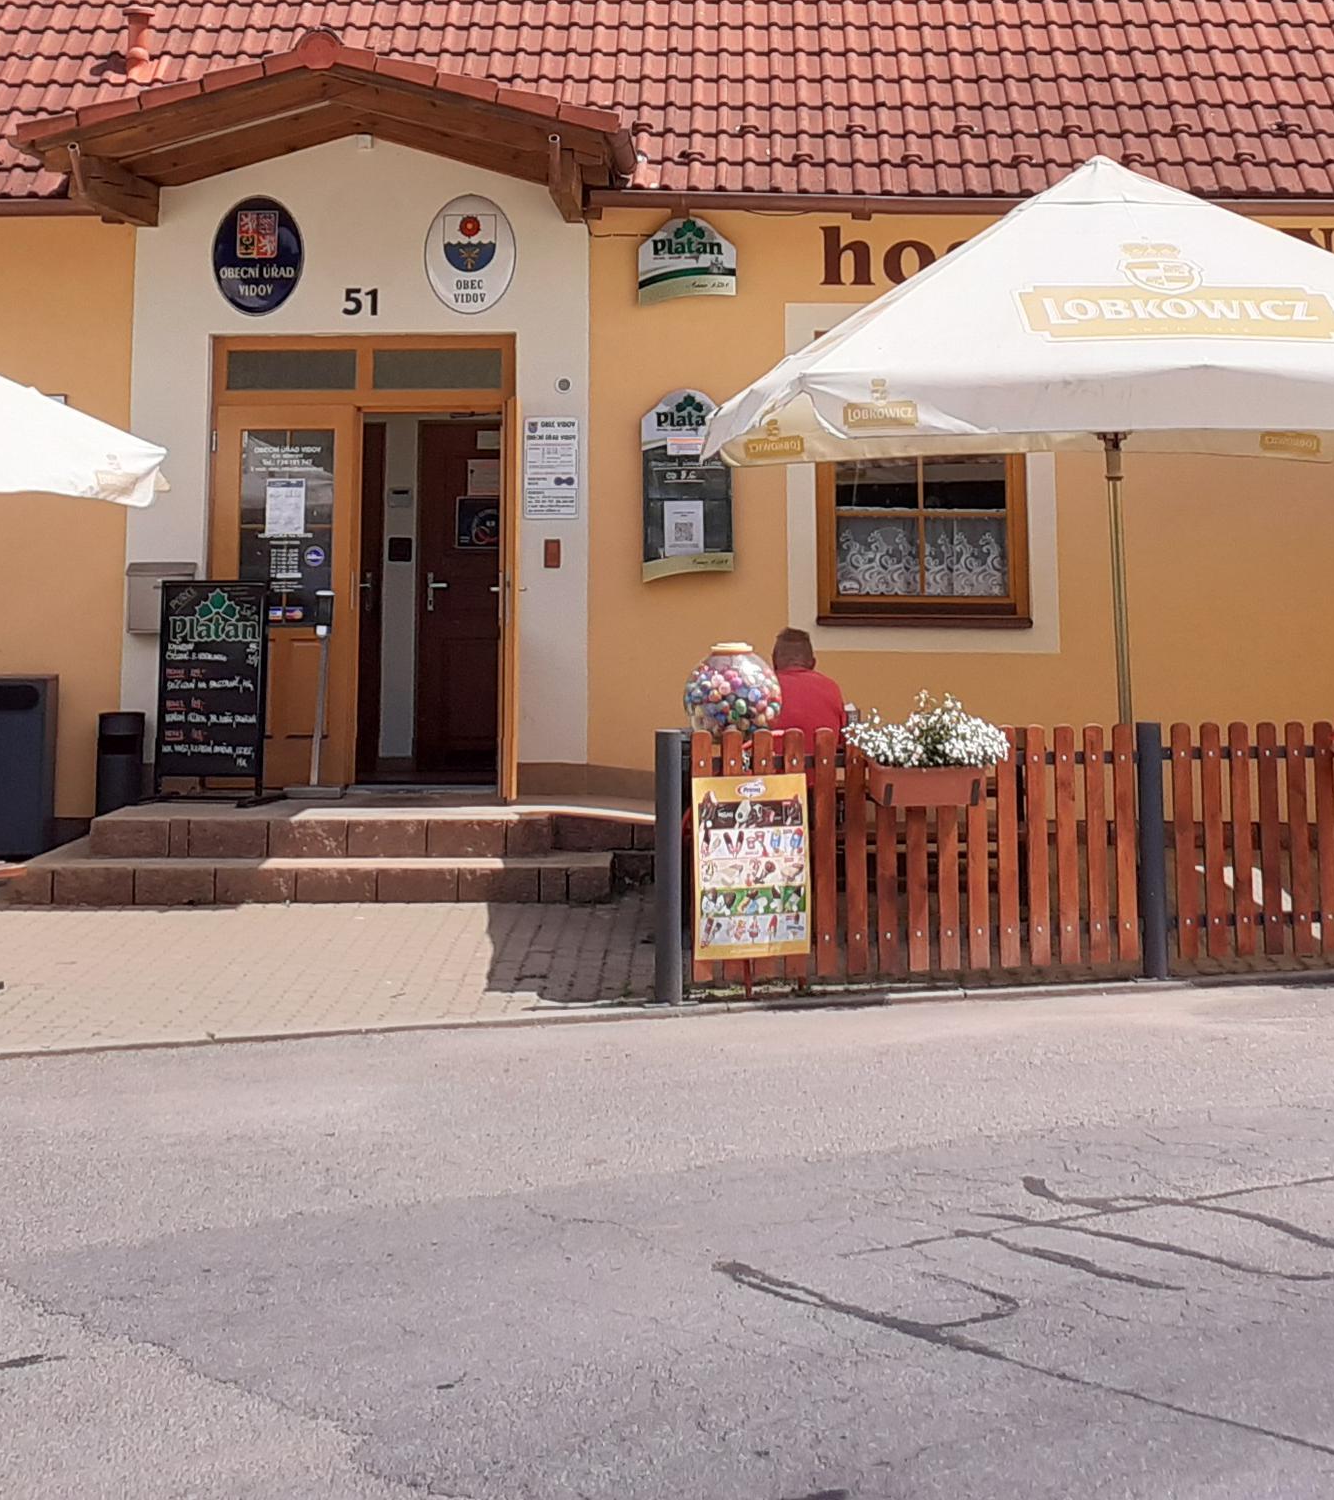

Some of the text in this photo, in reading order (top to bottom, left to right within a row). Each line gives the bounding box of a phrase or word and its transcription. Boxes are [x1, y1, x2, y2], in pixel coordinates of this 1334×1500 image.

[651, 237, 723, 256] Platan
[219, 263, 295, 280] OBECNÍ ÚŘAD
[238, 283, 274, 297] VIDOV
[455, 279, 484, 291] OBEC
[341, 288, 379, 317] 51
[453, 292, 486, 304] VIDOV
[1041, 297, 1319, 325] LOBKOWICZ
[655, 411, 707, 428] Plata
[847, 406, 915, 422] LOBKOWICZ
[169, 614, 260, 642] Platan
